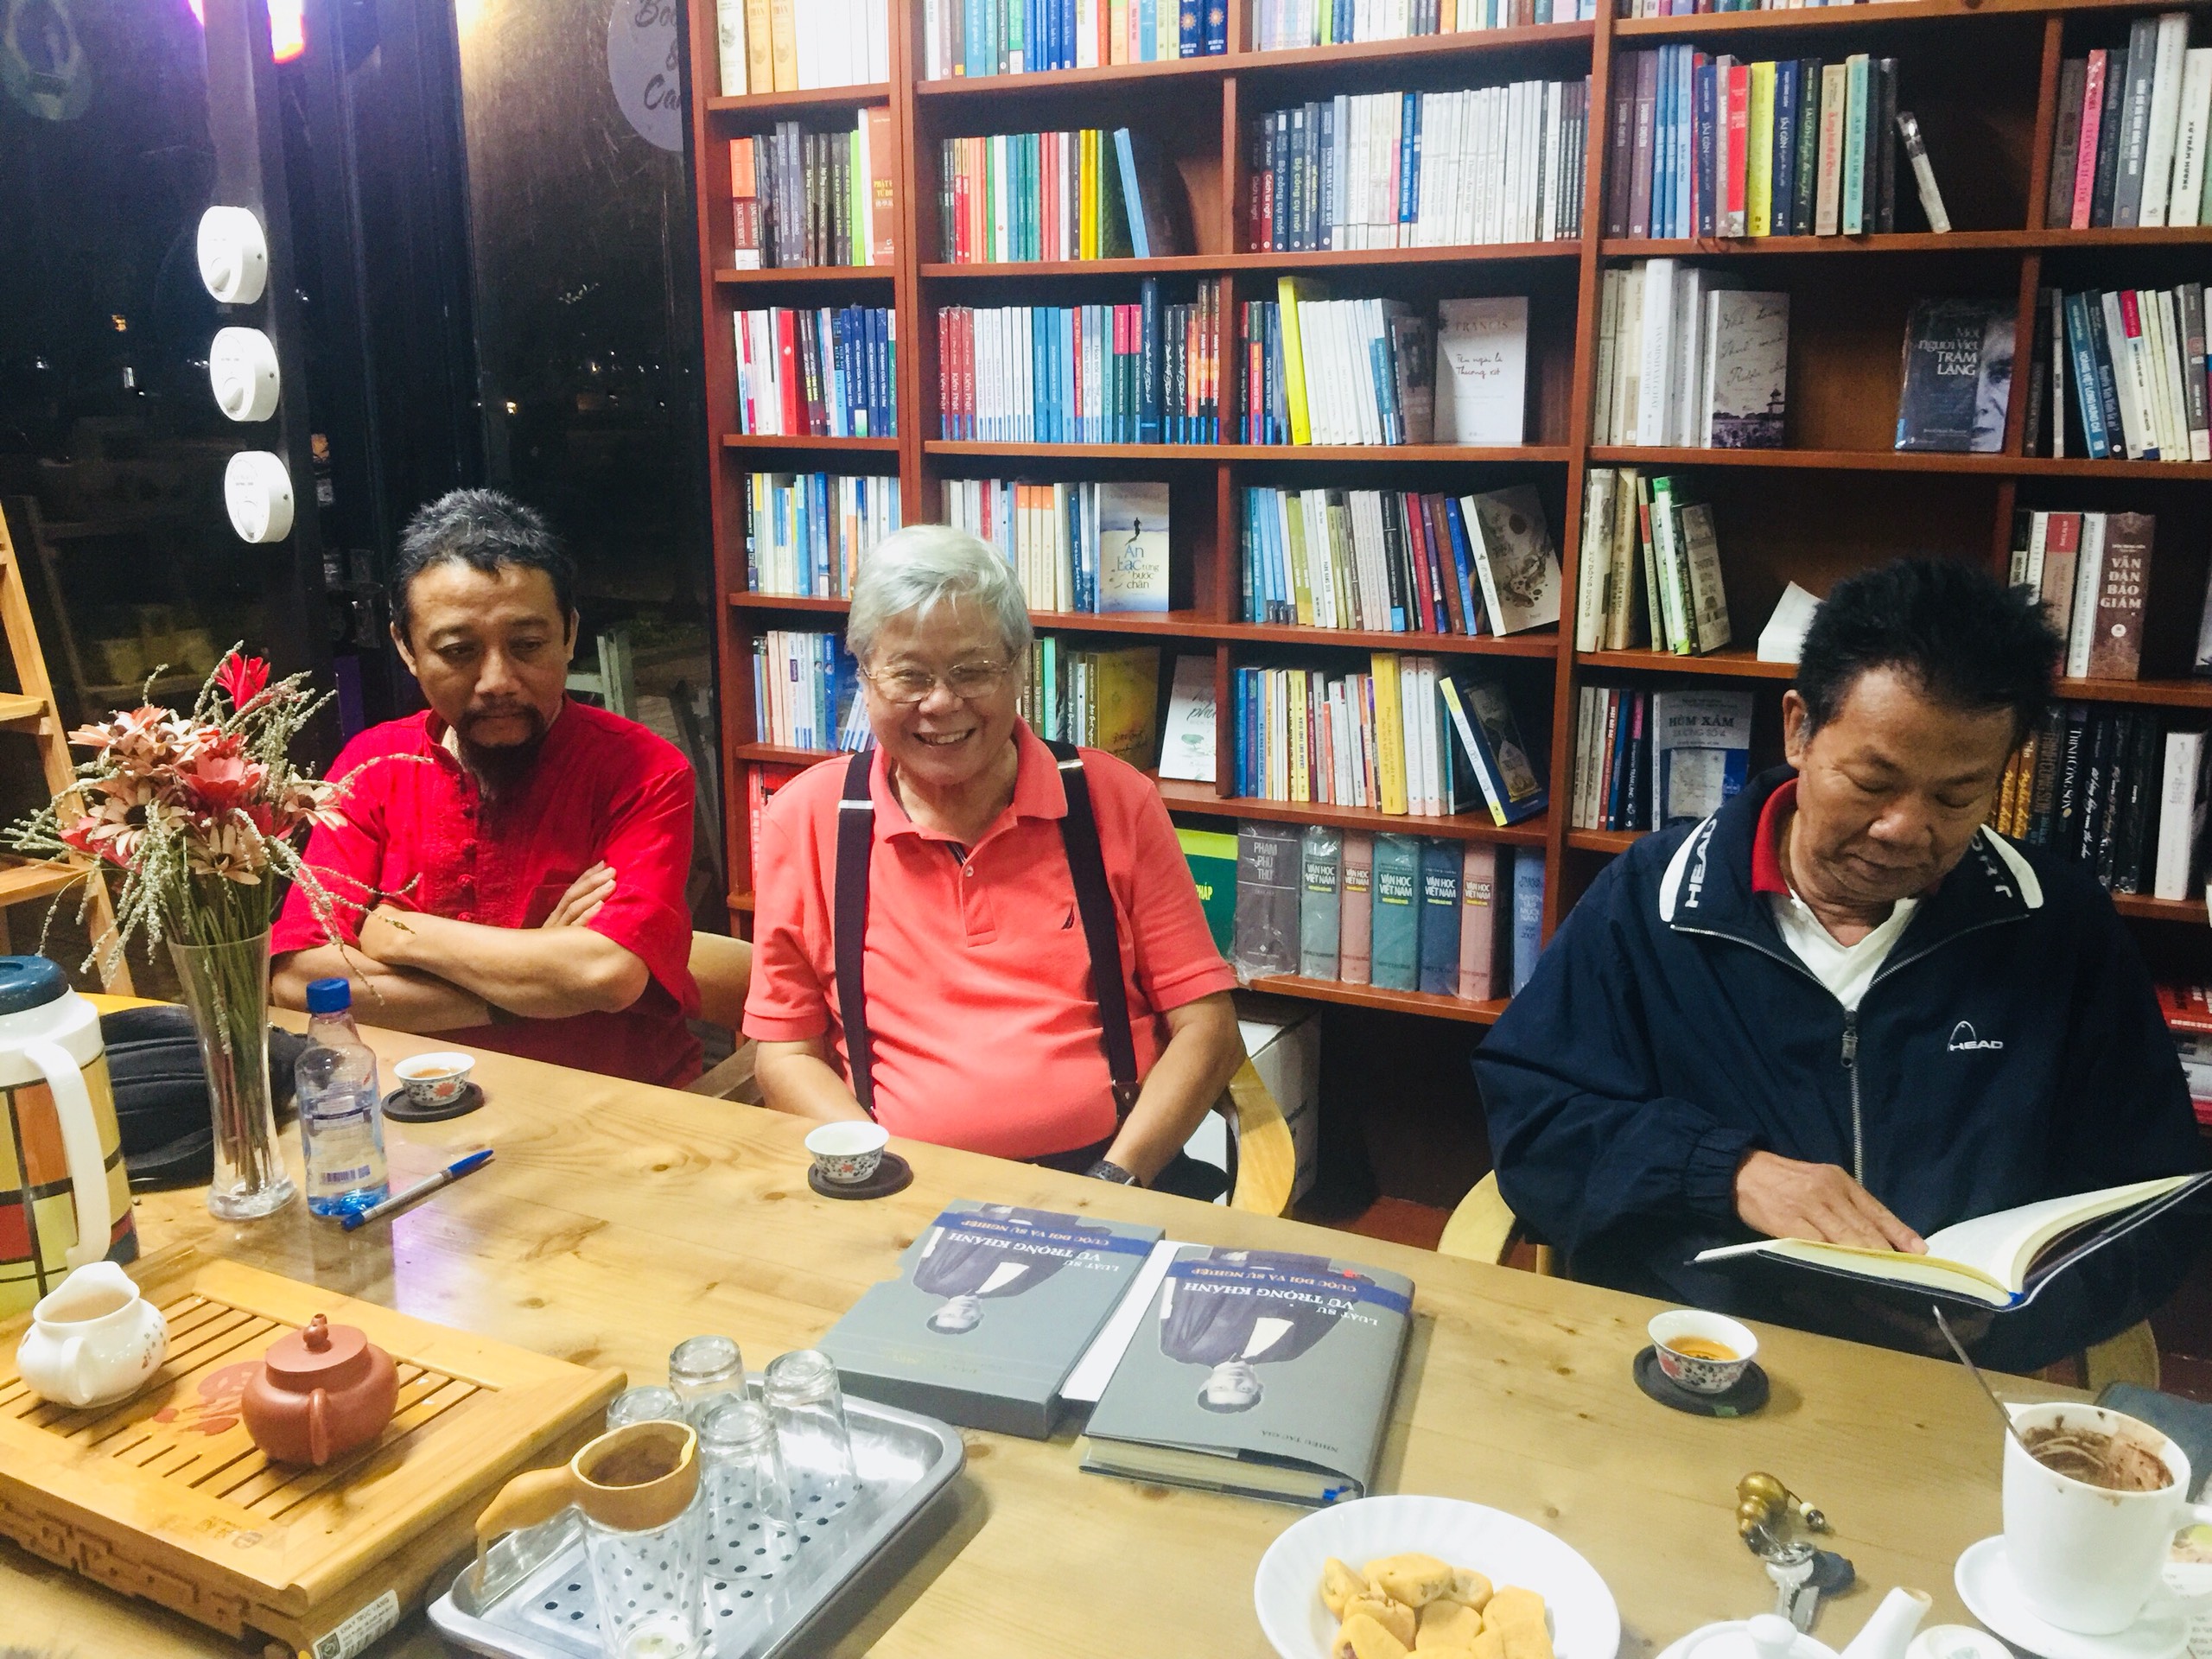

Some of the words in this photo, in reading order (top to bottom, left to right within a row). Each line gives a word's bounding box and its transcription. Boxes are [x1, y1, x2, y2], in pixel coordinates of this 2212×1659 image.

[1276, 161, 1286, 174] Bộ
[1293, 157, 1302, 171] Bộ
[1276, 176, 1285, 200] công
[1293, 174, 1302, 198] công
[1276, 202, 1283, 213] cụ
[1293, 200, 1300, 211] cụ
[1276, 216, 1286, 234] mới
[1294, 213, 1302, 232] mới
[1685, 817, 1718, 908] HEAD
[1307, 863, 1319, 876] VĂN
[1321, 864, 1336, 877] HỌC
[1346, 867, 1357, 878] VĂN
[1358, 868, 1369, 879] HỌC
[1306, 874, 1320, 886] VIỆT
[1321, 874, 1336, 886] NAM
[1344, 875, 1357, 886] VIỆT
[1358, 876, 1370, 886] NAM
[1381, 874, 1396, 887] VĂN
[1397, 874, 1411, 888] HỌC
[1427, 875, 1440, 888] VĂN
[1441, 876, 1455, 889] HỌC
[1466, 880, 1478, 891] VĂN
[1478, 880, 1491, 892] HỌC
[1380, 884, 1396, 897] VIỆT
[1397, 885, 1413, 897] NAM
[1425, 886, 1440, 899] VIỆT
[1441, 887, 1456, 899] NAM
[1465, 888, 1478, 899] VIỆT
[1478, 890, 1491, 899] NAM
[1950, 1040, 2004, 1051] HEAD
[961, 1219, 1010, 1233] NGHIỆP
[1012, 1225, 1027, 1236] SỰ
[1030, 1230, 1046, 1239] VÀ
[1048, 1231, 1072, 1243] ĐỜI
[1074, 1234, 1109, 1246] CUỘC
[946, 1232, 1009, 1251] KHÁNH
[1013, 1241, 1073, 1258] TRỌNG
[1073, 1249, 1101, 1262] VŨ
[1191, 1267, 1244, 1279] NGHIỆP
[1246, 1270, 1265, 1280] SỰ
[1268, 1273, 1287, 1282] VÀ
[1289, 1274, 1314, 1287] ĐỜI
[1317, 1279, 1357, 1294] CUỘC
[1183, 1282, 1252, 1296] KHÁNH
[1255, 1287, 1325, 1305] TRỌNG
[1327, 1297, 1355, 1311] VŨ
[1315, 1306, 1337, 1316] SƯ
[1341, 1311, 1378, 1326] LUẬT
